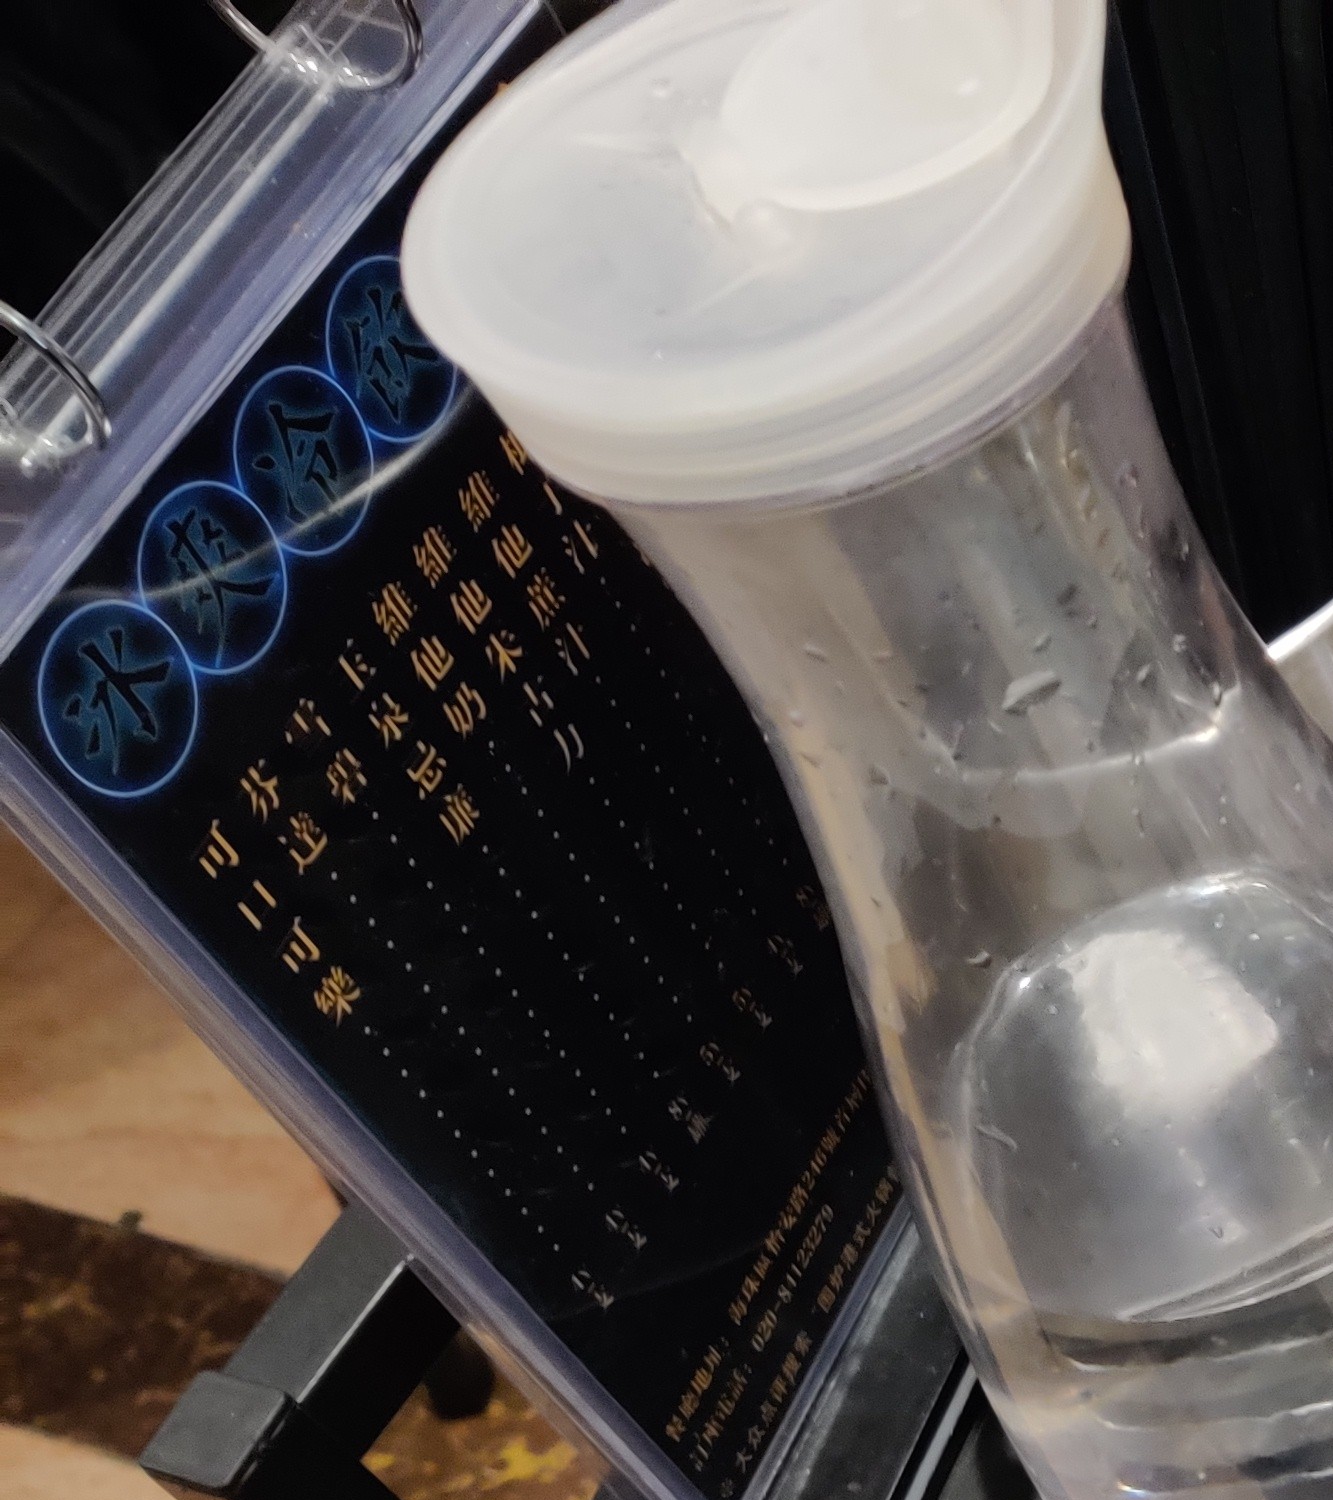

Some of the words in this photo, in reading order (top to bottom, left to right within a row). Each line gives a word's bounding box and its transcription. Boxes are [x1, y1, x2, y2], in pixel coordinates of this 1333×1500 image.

[373, 583, 488, 736] 維他奶
[200, 820, 362, 1024] 可口可樂
